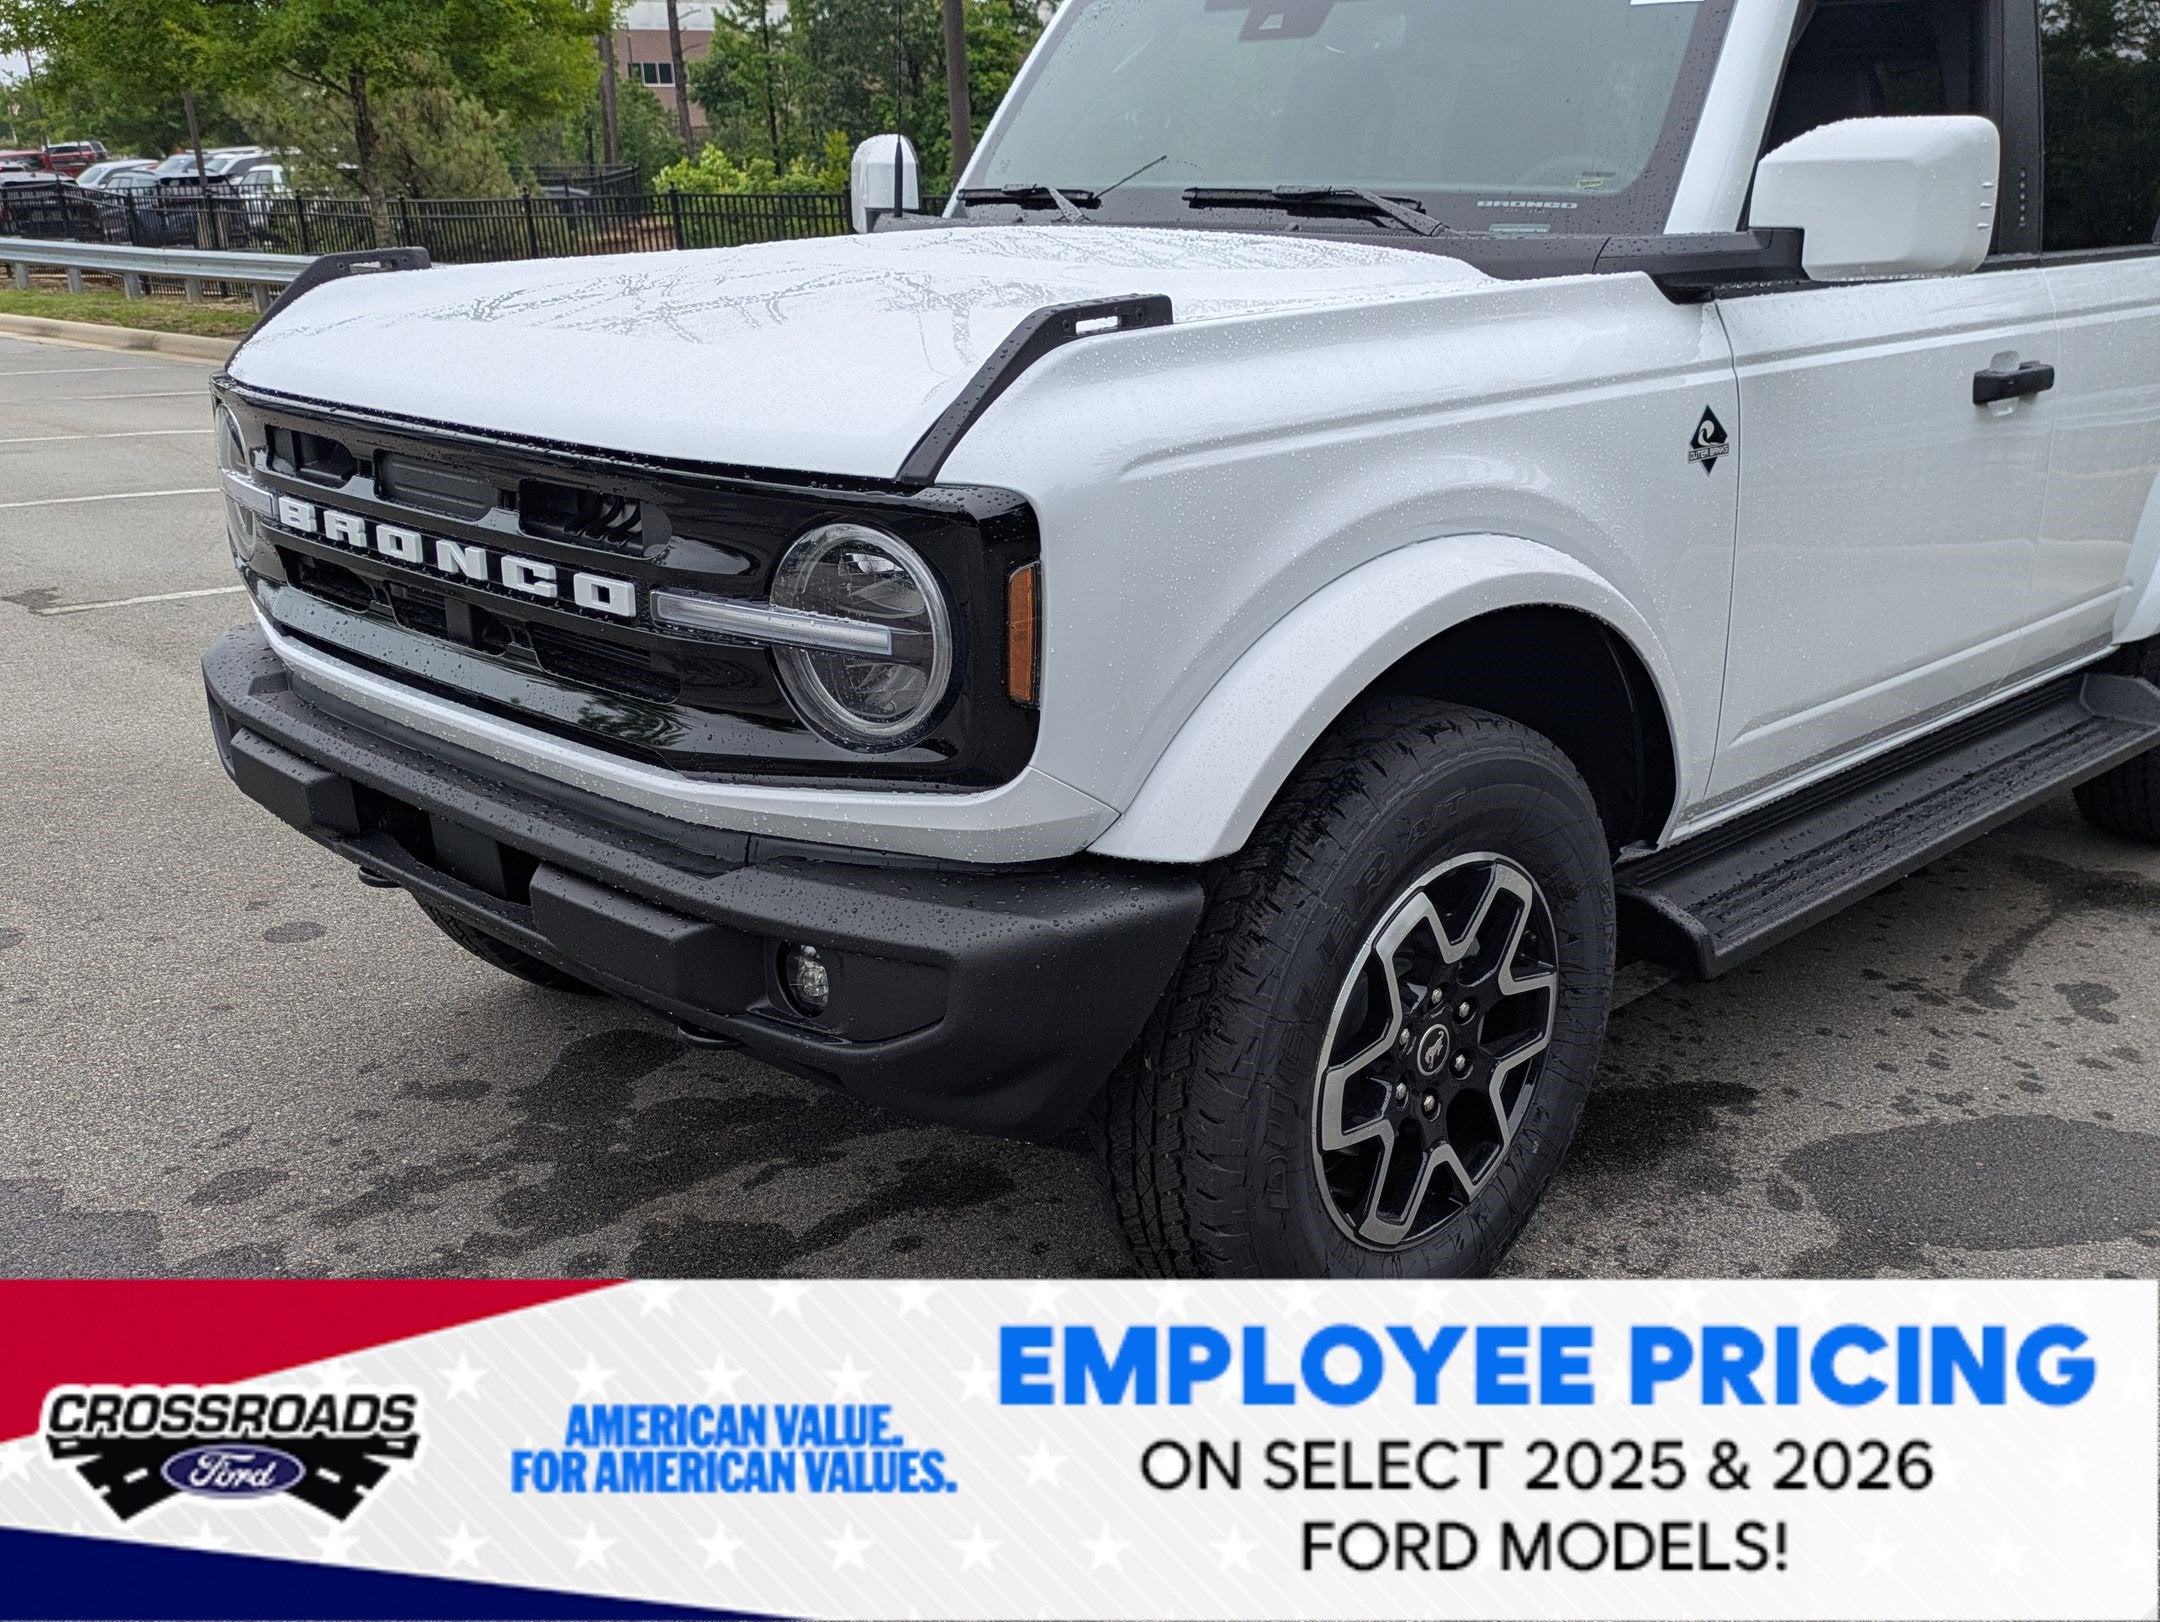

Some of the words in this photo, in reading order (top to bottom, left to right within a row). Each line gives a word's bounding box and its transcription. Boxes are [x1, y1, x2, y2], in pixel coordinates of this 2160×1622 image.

[1477, 200, 1578, 209] BRONCO
[1689, 447, 1708, 461] OUTER
[1709, 444, 1729, 457] BANKS
[278, 495, 637, 618] BRONCO
